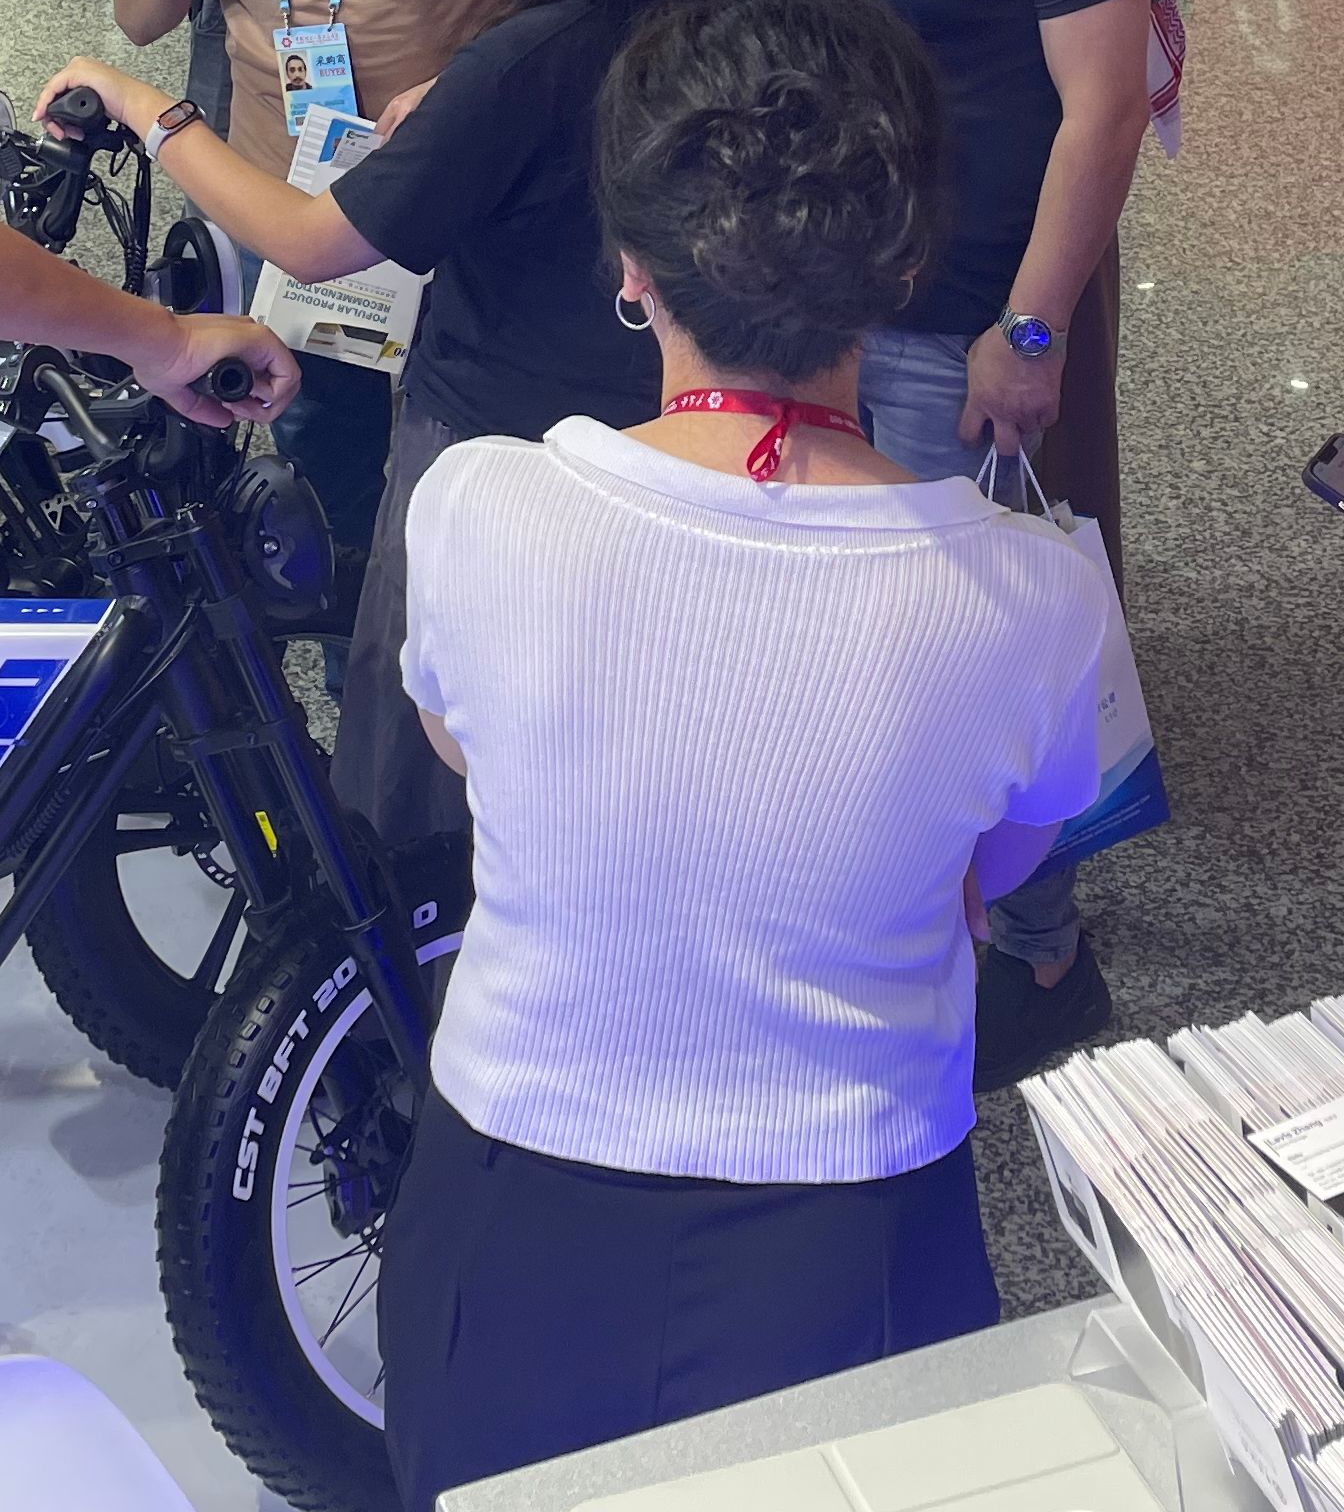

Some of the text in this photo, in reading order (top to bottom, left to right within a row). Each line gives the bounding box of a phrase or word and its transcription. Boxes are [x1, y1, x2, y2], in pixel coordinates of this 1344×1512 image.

[319, 67, 347, 78] BUYER
[282, 290, 388, 325] POPULAR PRODUCT
[232, 955, 358, 1202] CST BFT 20
